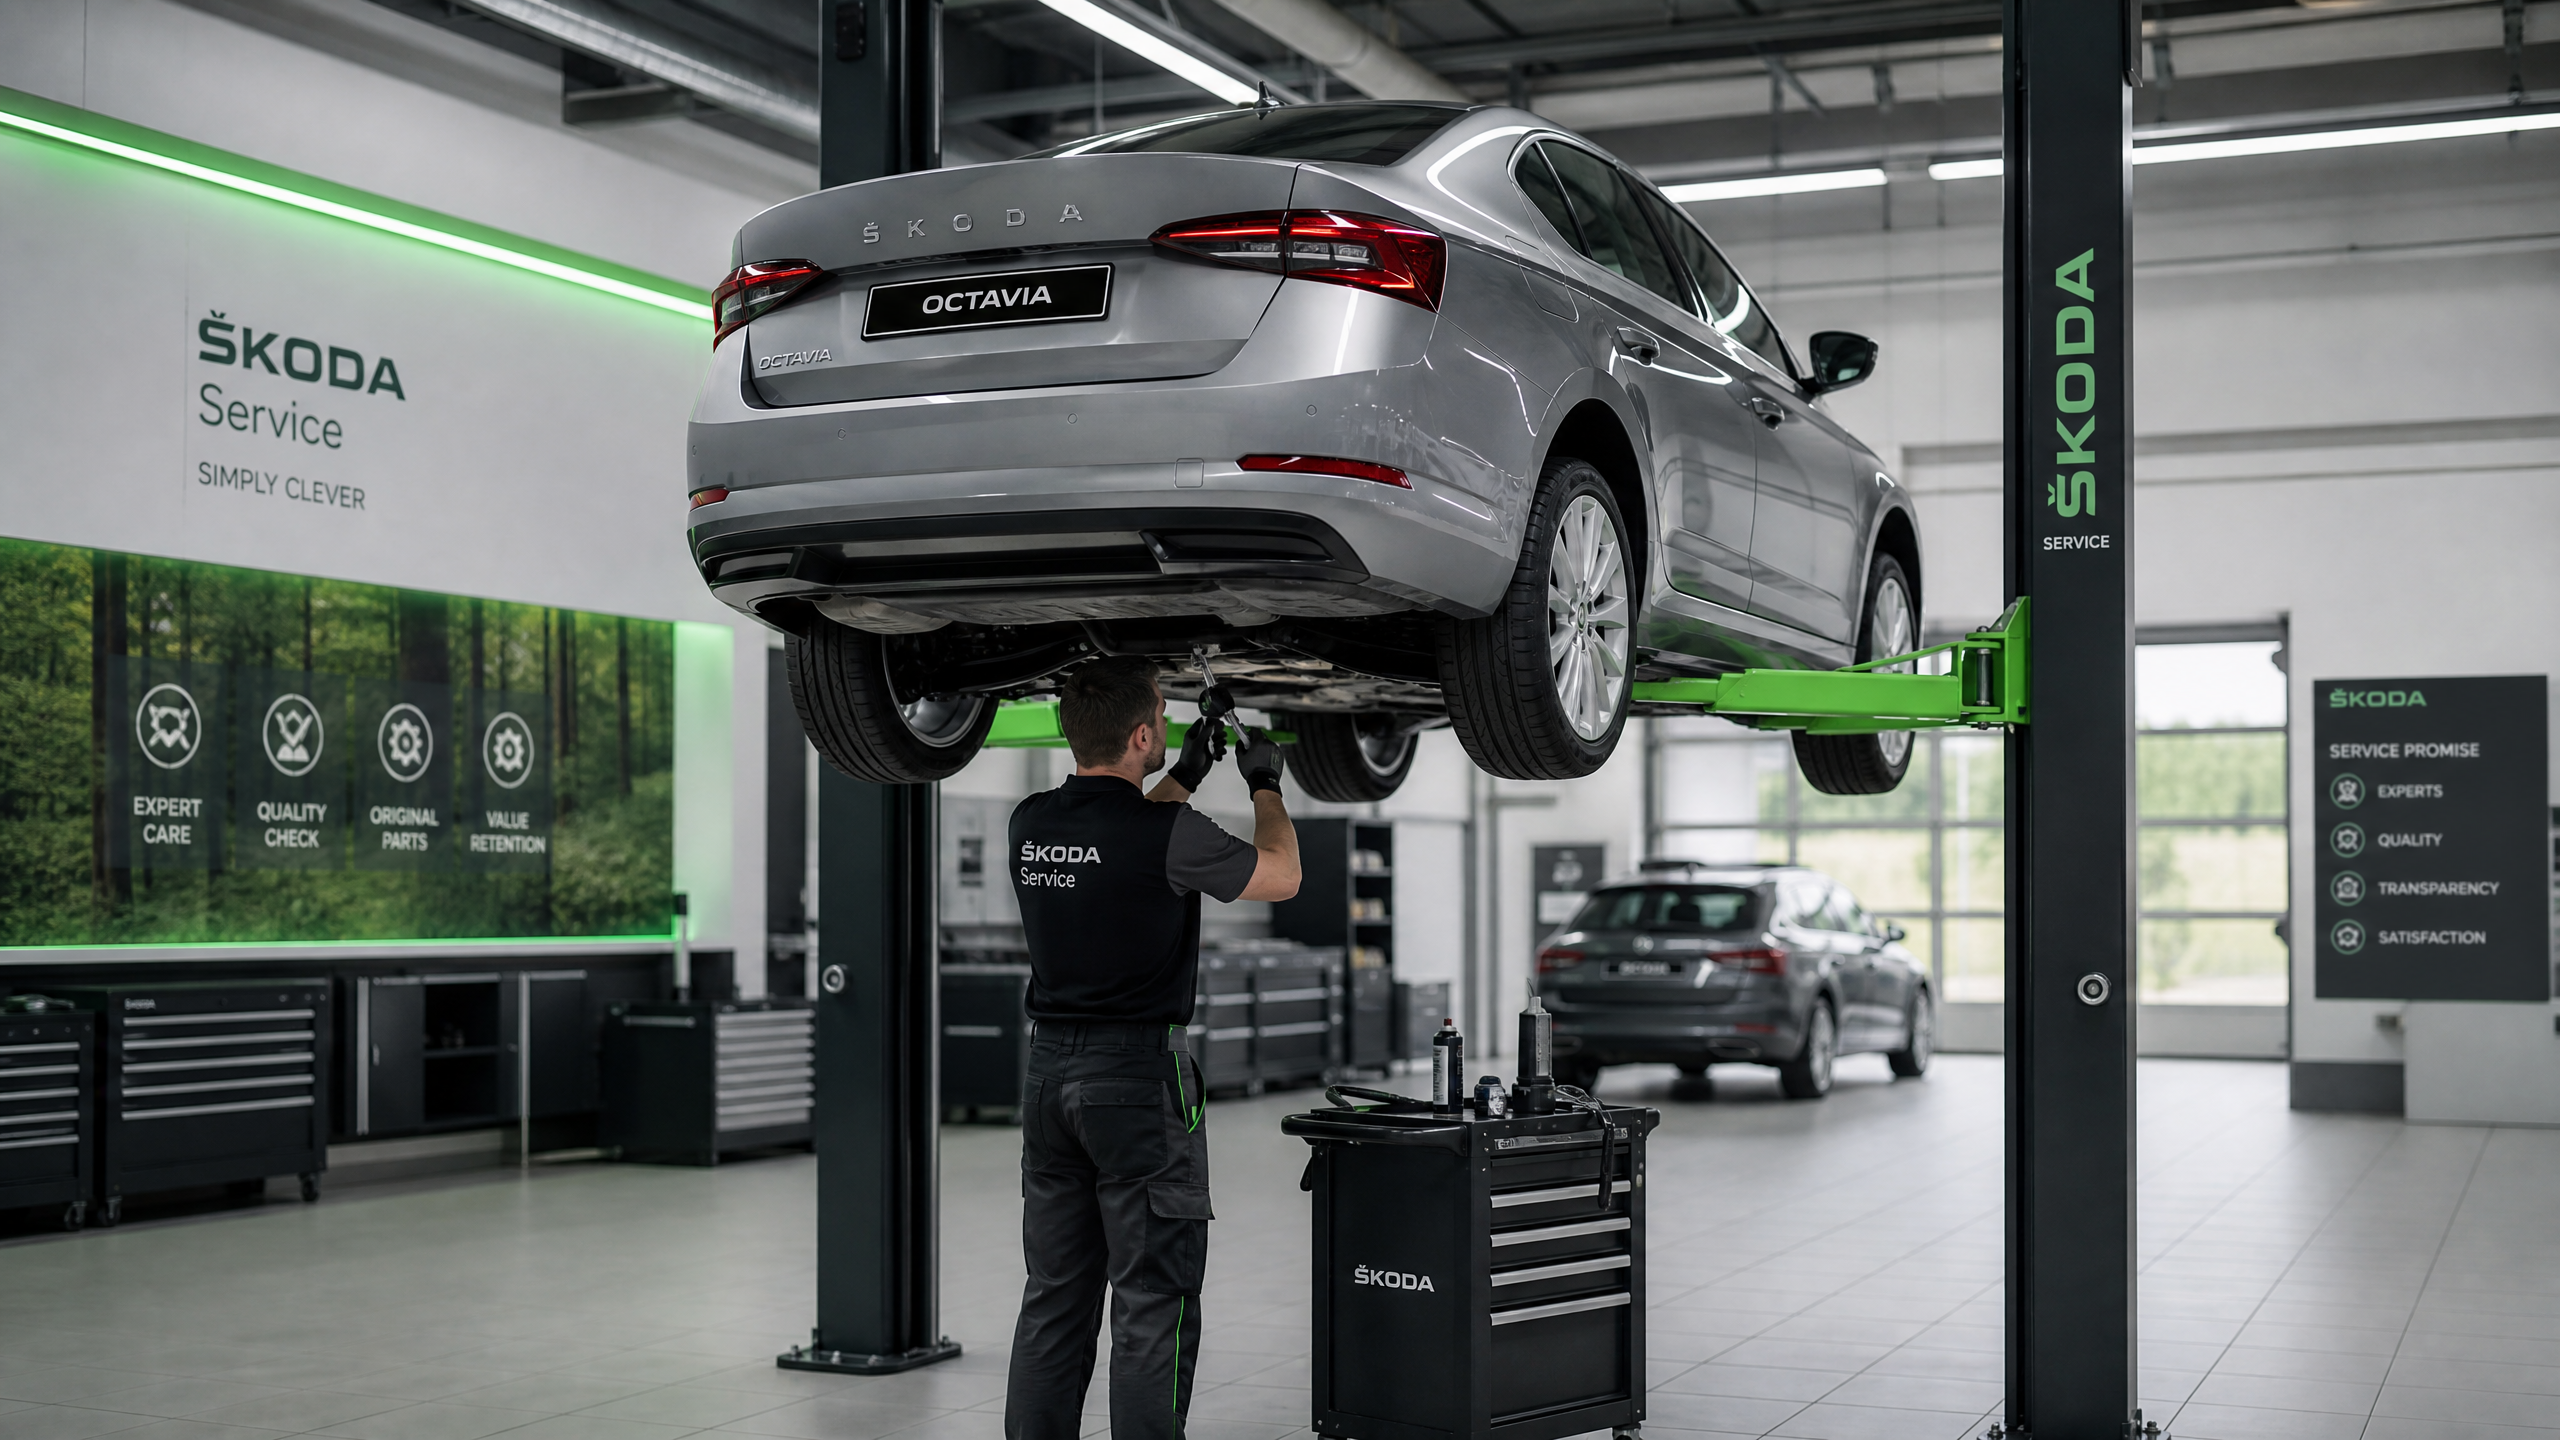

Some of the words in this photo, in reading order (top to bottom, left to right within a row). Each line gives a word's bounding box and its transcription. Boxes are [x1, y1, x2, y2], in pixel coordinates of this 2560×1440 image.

[863, 204, 1083, 244] ŠKODA
[922, 286, 1052, 314] OCTAVIA
[198, 309, 406, 402] ŠKODA
[759, 348, 832, 370] OCTAVIA
[2047, 247, 2096, 517] ŠKODA
[199, 382, 343, 450] Service
[198, 461, 278, 495] SIMPLY
[285, 476, 366, 510] CLEVER
[2043, 535, 2110, 550] SERVICE
[2329, 688, 2428, 708] ŠKODA
[2329, 743, 2400, 759] SERVICE
[2404, 742, 2480, 758] PROMISE
[2377, 784, 2443, 799] EXPERTS
[133, 795, 203, 818] EXPERT
[256, 801, 328, 824] QUALITY
[369, 805, 440, 827] ORIGINAL
[486, 810, 530, 830] VALUE
[142, 823, 192, 845] CARE
[264, 827, 320, 849] CHECK
[381, 830, 428, 851] PARTS
[469, 833, 546, 854] RETENTION
[2377, 832, 2443, 848] QUALITY
[1020, 840, 1102, 864] ŠKODA
[1020, 866, 1076, 888] Service
[2377, 881, 2500, 896] TRANSPARENCY
[2378, 930, 2487, 945] SATISFACTION
[1354, 1263, 1435, 1293] ŠKODA
